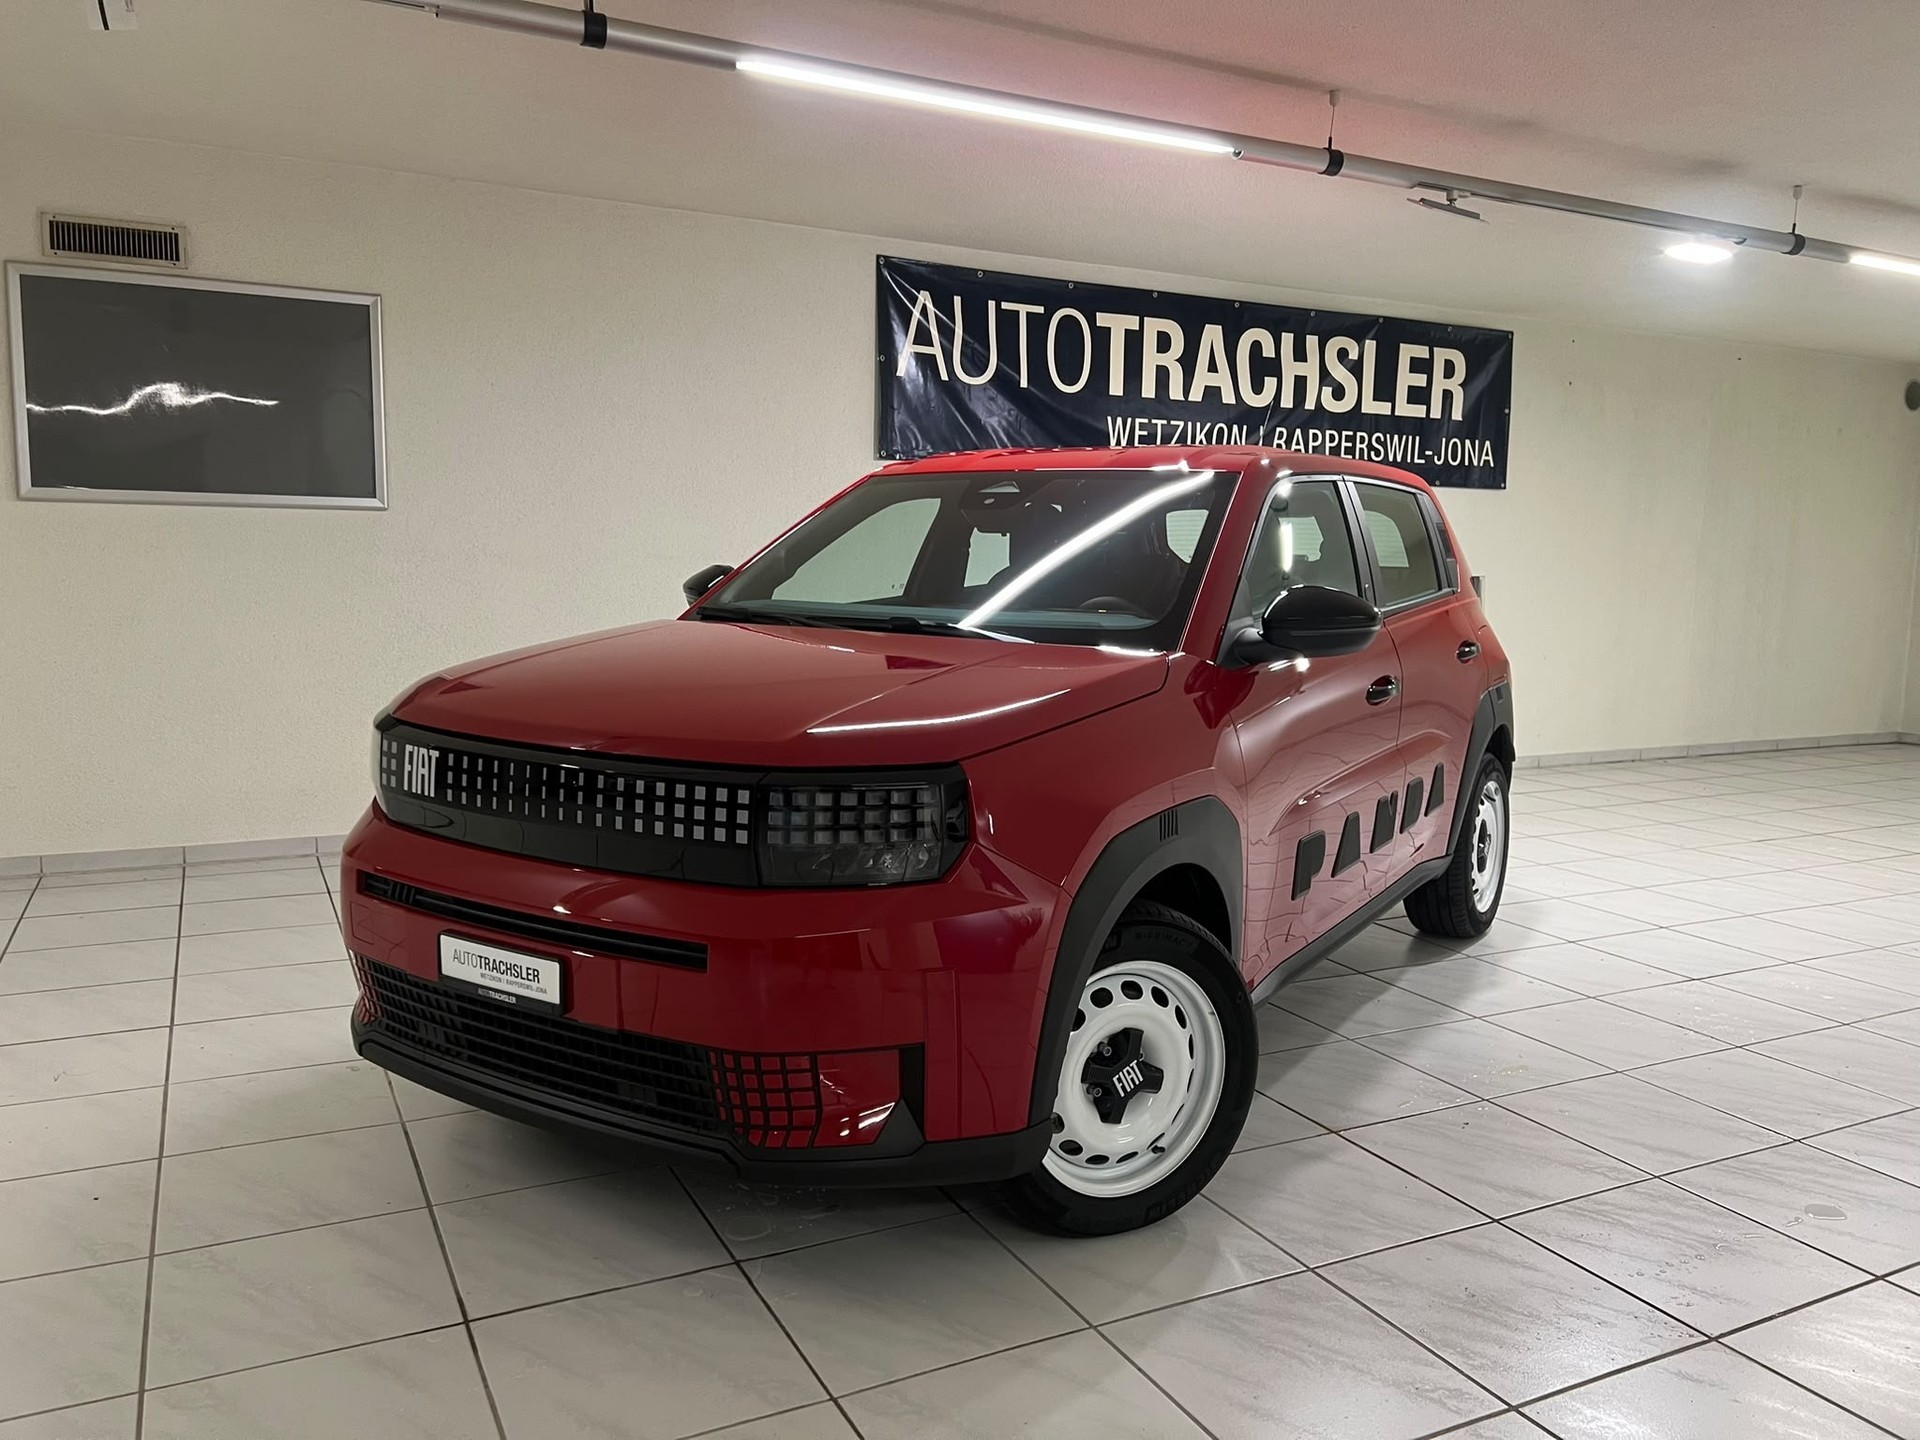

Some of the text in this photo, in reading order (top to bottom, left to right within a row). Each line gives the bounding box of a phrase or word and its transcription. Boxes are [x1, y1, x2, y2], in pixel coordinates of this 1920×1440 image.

[895, 289, 1467, 422] AUTOTRACHSLER
[1106, 415, 1248, 447] WETZIKON
[1272, 426, 1495, 468] RAPPERSWIL-JONA
[403, 743, 440, 798] FIAT
[1291, 761, 1445, 901] PANDA
[452, 948, 541, 984] AUTOTRACHSLER
[1112, 1059, 1144, 1098] FIAT
